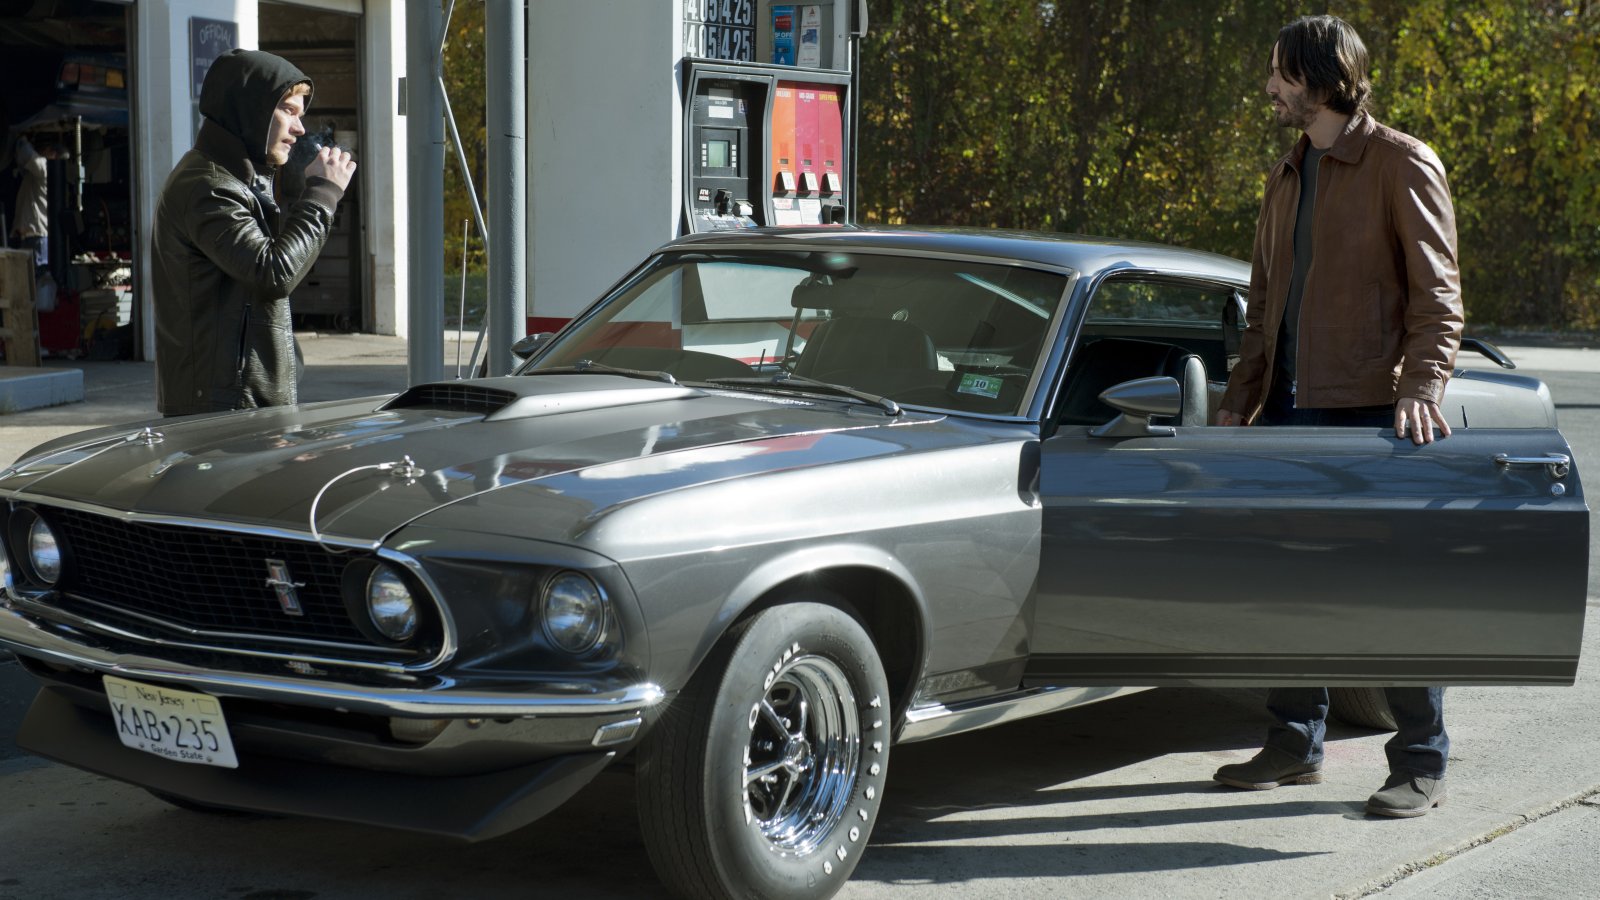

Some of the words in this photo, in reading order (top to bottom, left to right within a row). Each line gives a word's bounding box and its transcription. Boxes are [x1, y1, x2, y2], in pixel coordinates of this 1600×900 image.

[199, 23, 232, 49] OFFICIAL
[975, 380, 987, 389] 10
[136, 687, 157, 703] New
[158, 690, 185, 709] Jersey
[151, 744, 178, 758] Garden
[179, 749, 204, 761] State
